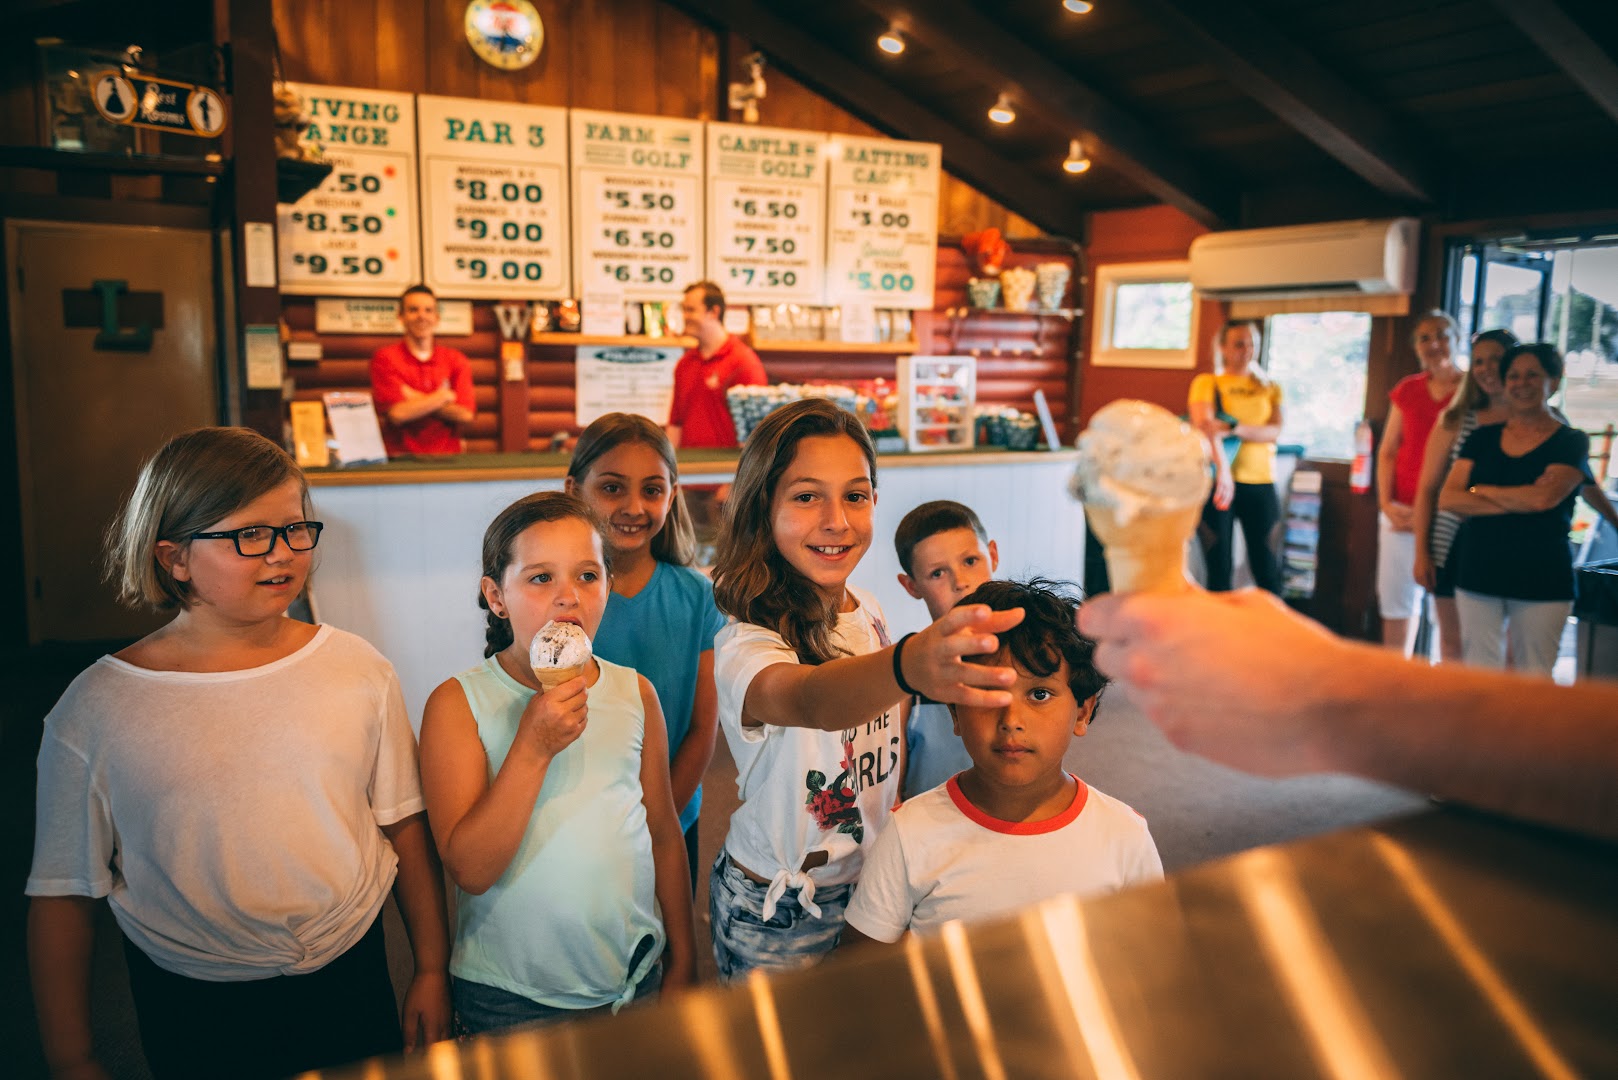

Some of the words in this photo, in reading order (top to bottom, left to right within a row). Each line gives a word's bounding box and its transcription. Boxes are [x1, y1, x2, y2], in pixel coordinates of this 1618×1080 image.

[310, 97, 399, 123] IVING
[305, 123, 389, 146] ANGE
[444, 117, 514, 145] PAR
[528, 124, 545, 148] 3
[585, 122, 655, 143] FARM
[718, 134, 799, 156] CASTLE
[632, 149, 690, 168] GOLF
[761, 159, 814, 179] GOLF
[330, 173, 381, 193] .50
[455, 179, 542, 203] $8.00
[604, 190, 675, 210] $5.50
[734, 199, 797, 218] $6.50
[292, 212, 382, 234] $8.50
[455, 218, 542, 242] $9.00
[603, 228, 674, 248] $6.50
[734, 236, 796, 254] $7.50
[294, 253, 383, 275] $9.50
[455, 258, 542, 281] $9.00
[603, 264, 674, 283] $6.50
[731, 267, 796, 287] $7.50
[848, 271, 914, 291] $5.00
[493, 304, 531, 340] W
